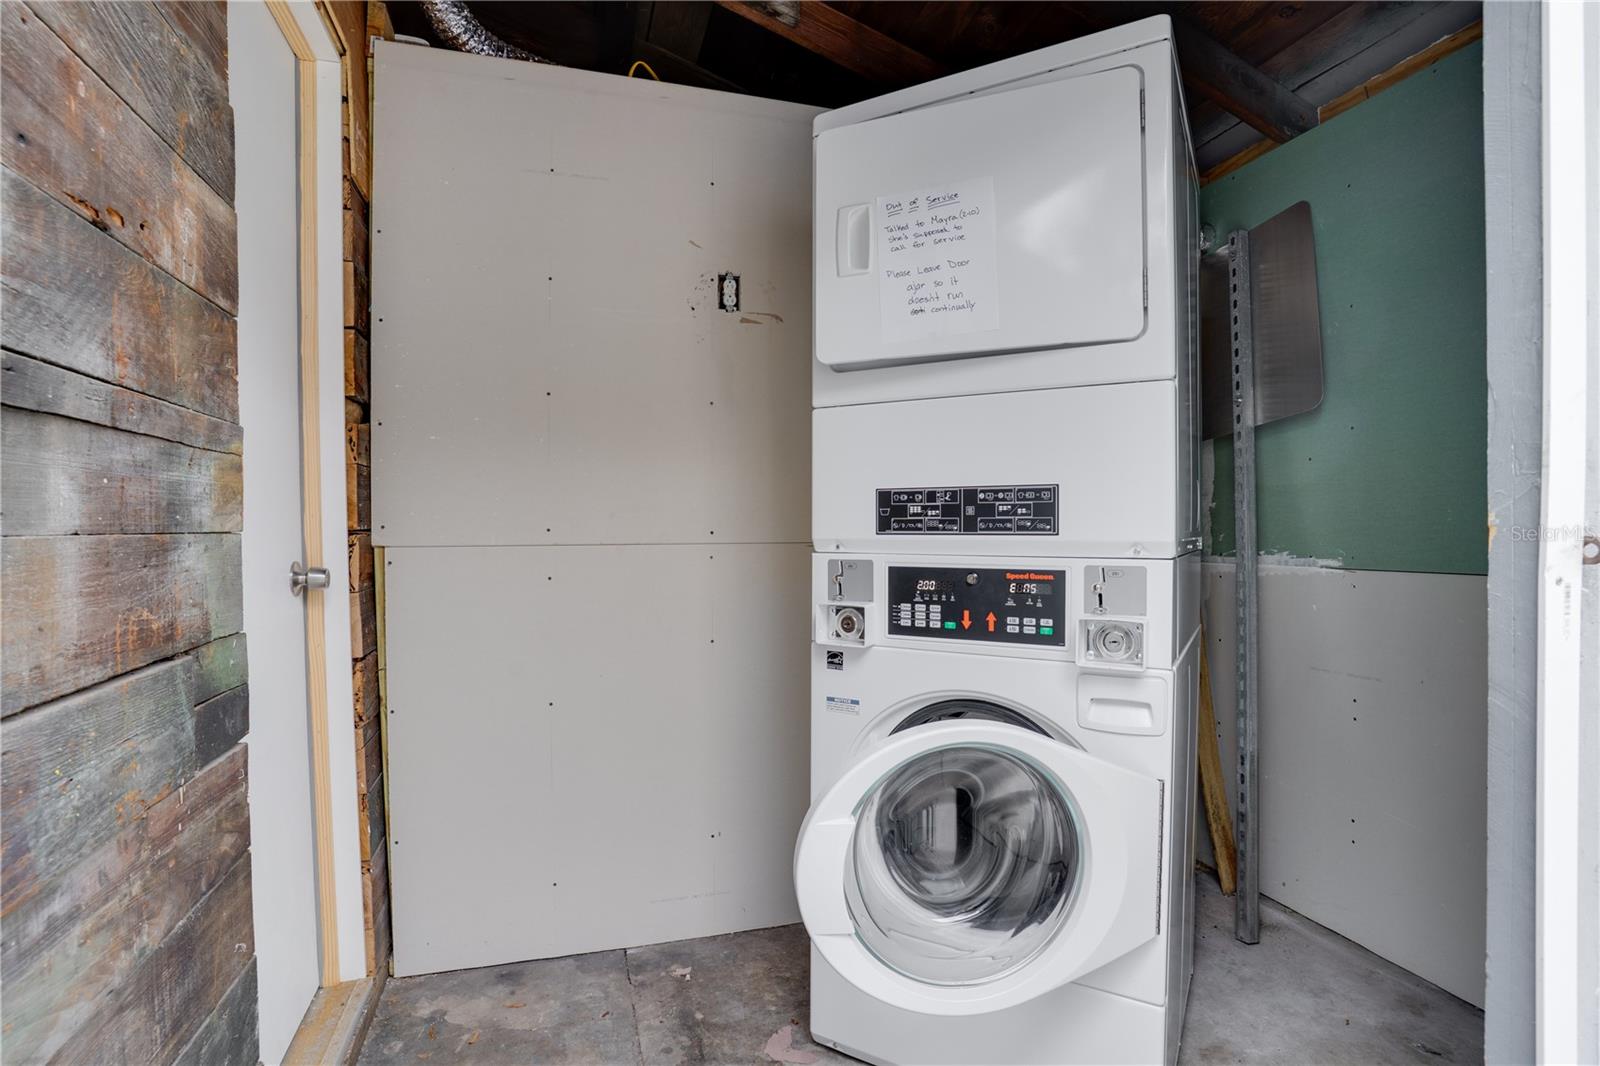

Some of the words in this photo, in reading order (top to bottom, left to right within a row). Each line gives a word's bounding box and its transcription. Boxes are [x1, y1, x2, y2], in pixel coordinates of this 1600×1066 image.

[886, 202, 902, 211] Out
[926, 193, 960, 205] Service
[884, 223, 910, 233] Talked
[915, 219, 926, 228] to
[954, 222, 962, 231] to
[890, 244, 906, 252] call
[912, 241, 925, 249] for
[933, 234, 966, 245] service
[886, 269, 911, 279] Please
[917, 264, 941, 275] Leave
[947, 259, 970, 269] Door
[906, 281, 926, 295] ajar
[933, 280, 944, 288] so
[950, 275, 959, 286] it
[947, 291, 964, 301] run
[931, 299, 976, 313] continually
[1006, 572, 1029, 581] Speed
[1029, 572, 1054, 581] Queen
